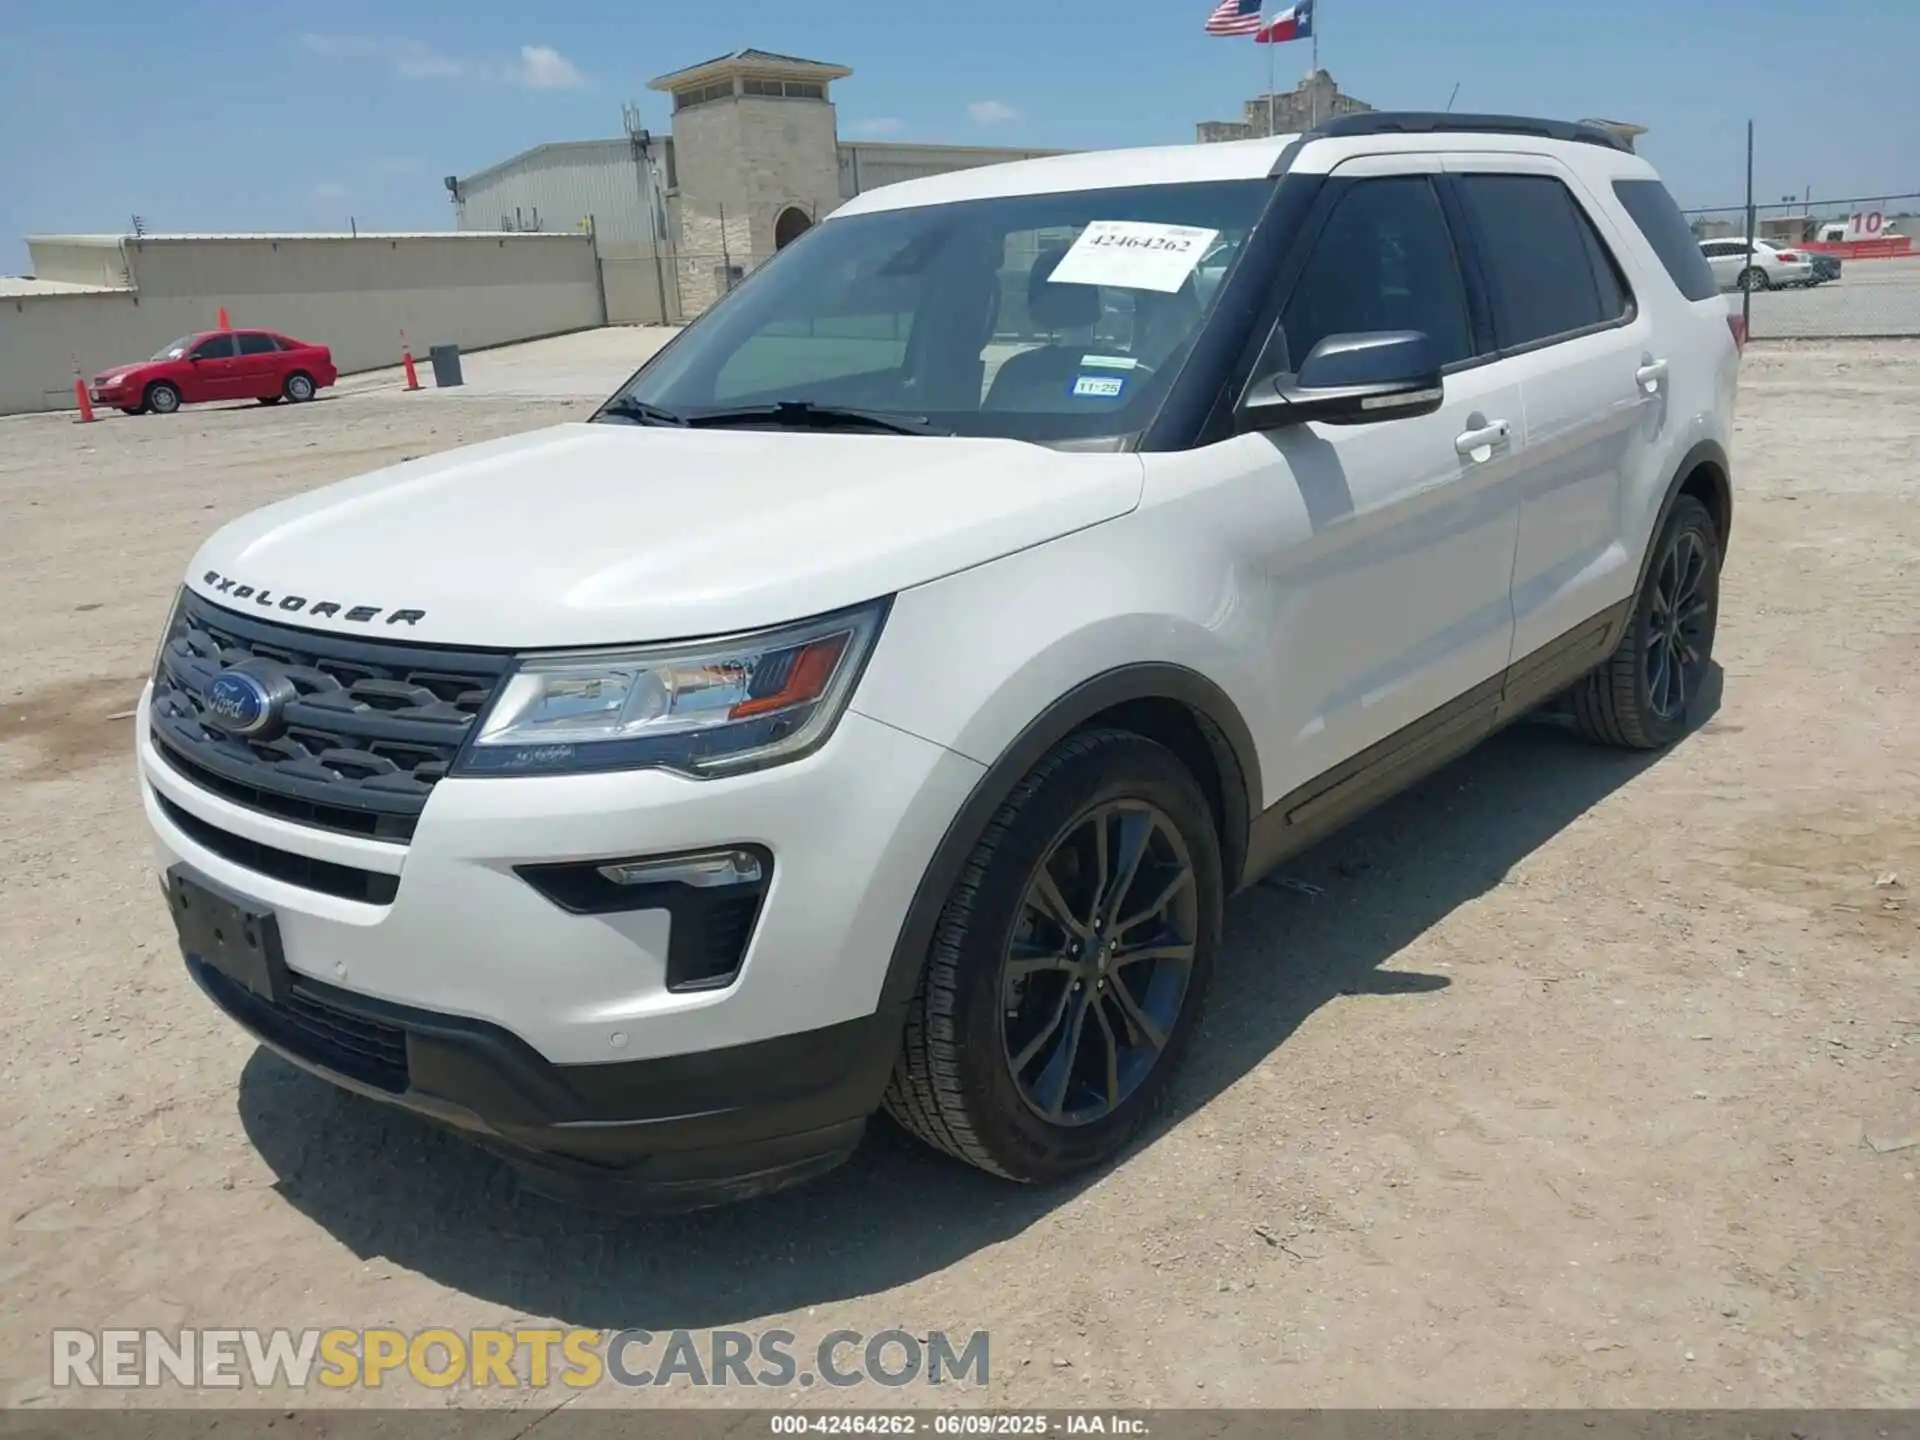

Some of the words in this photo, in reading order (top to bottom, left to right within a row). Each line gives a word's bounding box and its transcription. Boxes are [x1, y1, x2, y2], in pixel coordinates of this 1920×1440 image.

[1851, 211, 1882, 234] 10
[1089, 234, 1192, 253] 42464262
[203, 570, 427, 626] EXPLORER
[208, 680, 246, 720] Ford
